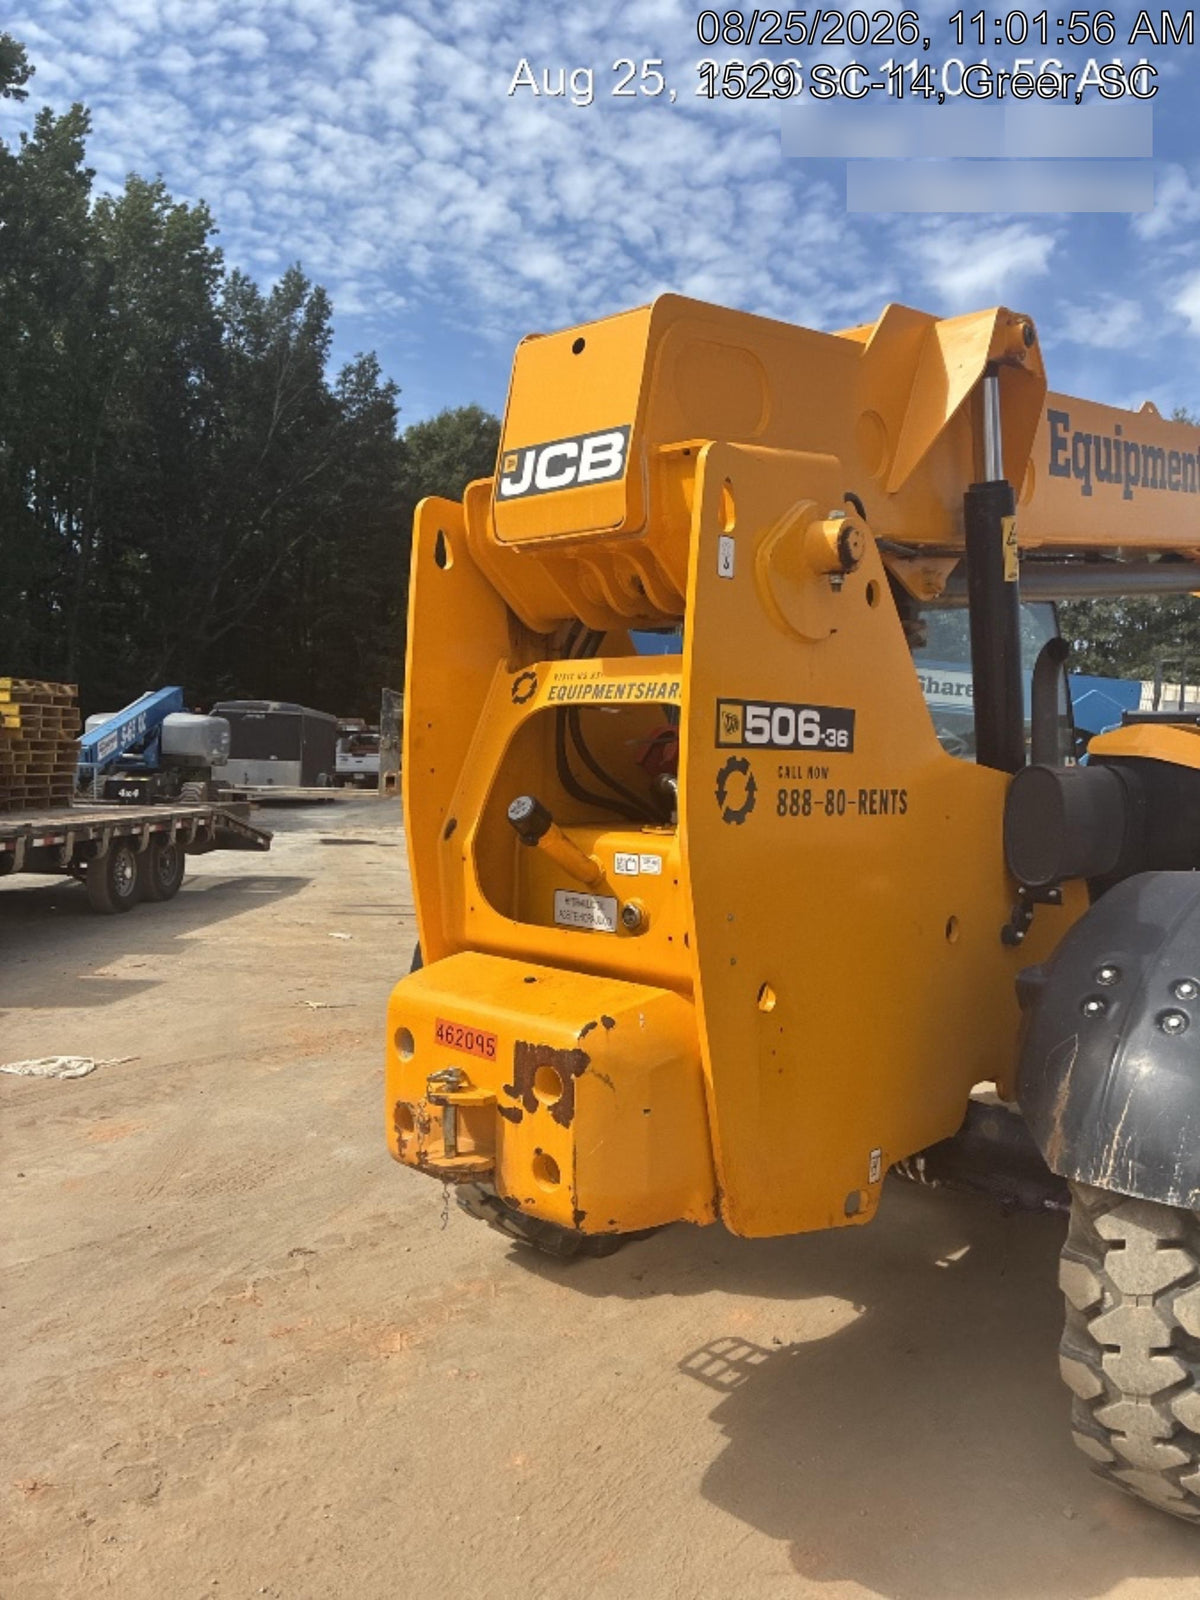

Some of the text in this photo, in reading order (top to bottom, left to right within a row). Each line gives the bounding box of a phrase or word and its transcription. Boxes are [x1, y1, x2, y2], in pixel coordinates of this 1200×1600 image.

[501, 431, 625, 497] JCB
[550, 682, 682, 700] EQUIPMENTSHAR
[778, 766, 829, 779] CALL NOW
[118, 788, 140, 798] 4x4
[777, 789, 908, 816] 888-80-RENTS
[436, 1024, 495, 1057] 462095
